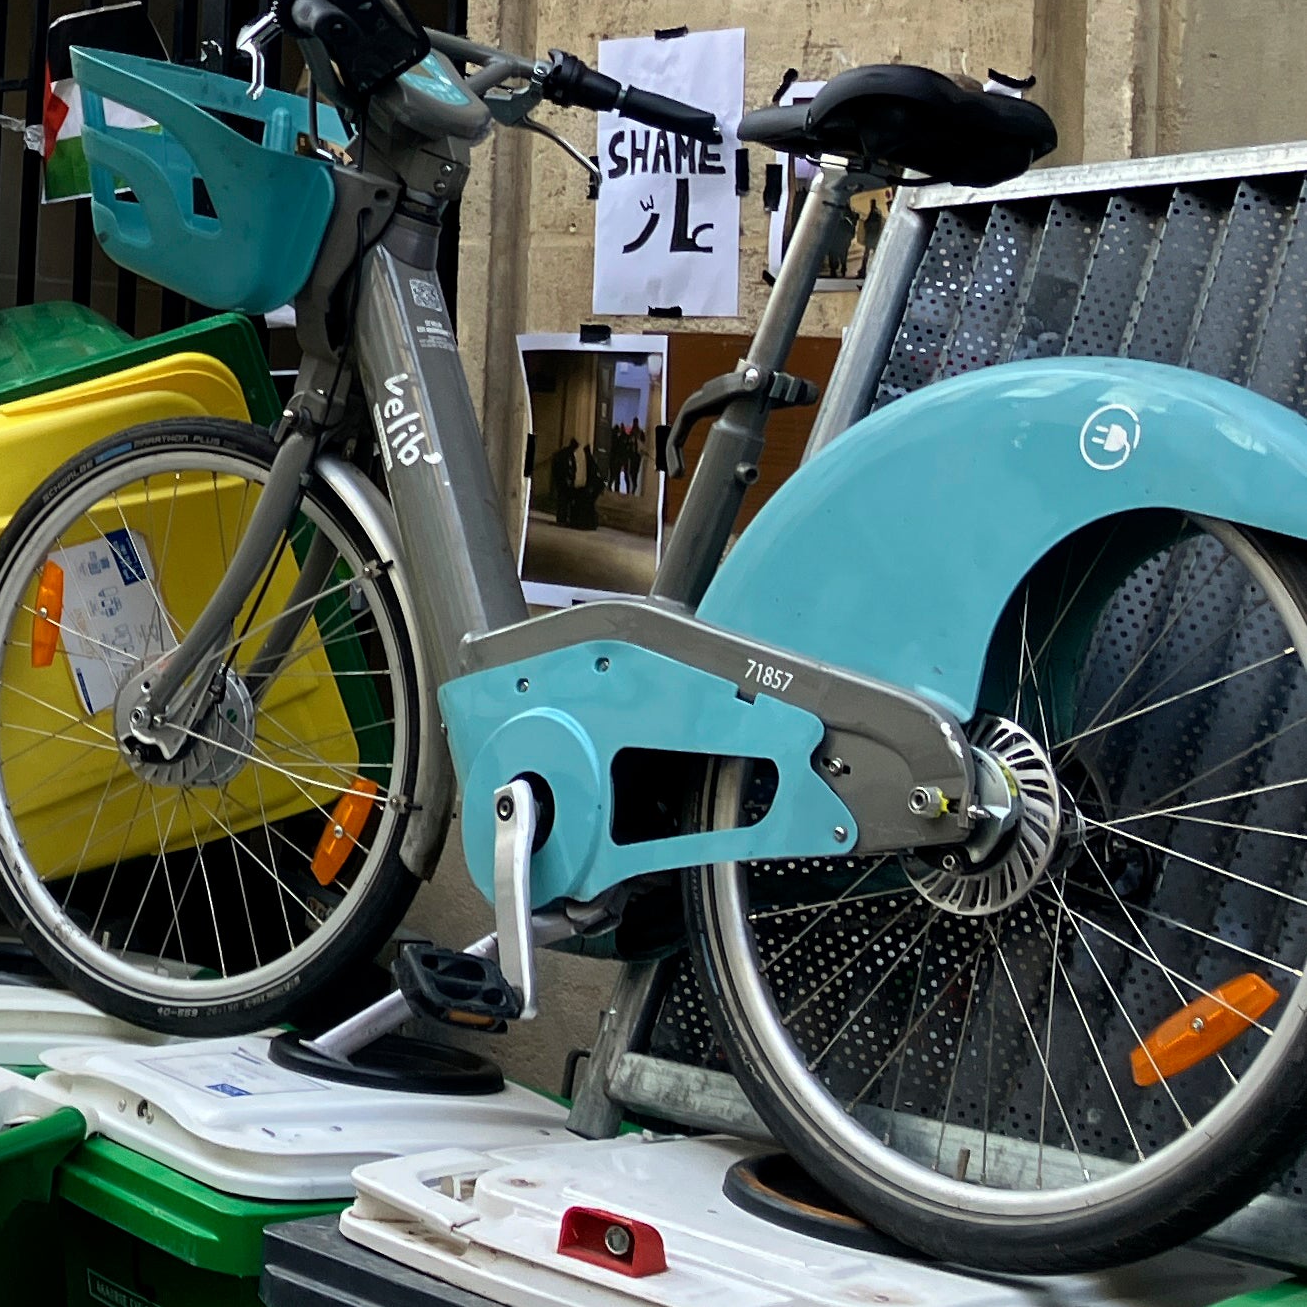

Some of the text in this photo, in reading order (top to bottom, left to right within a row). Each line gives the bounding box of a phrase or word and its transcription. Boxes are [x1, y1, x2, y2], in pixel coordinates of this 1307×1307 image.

[608, 129, 726, 179] SHAME
[42, 459, 95, 505] SCHWALBE
[745, 658, 794, 692] 71857
